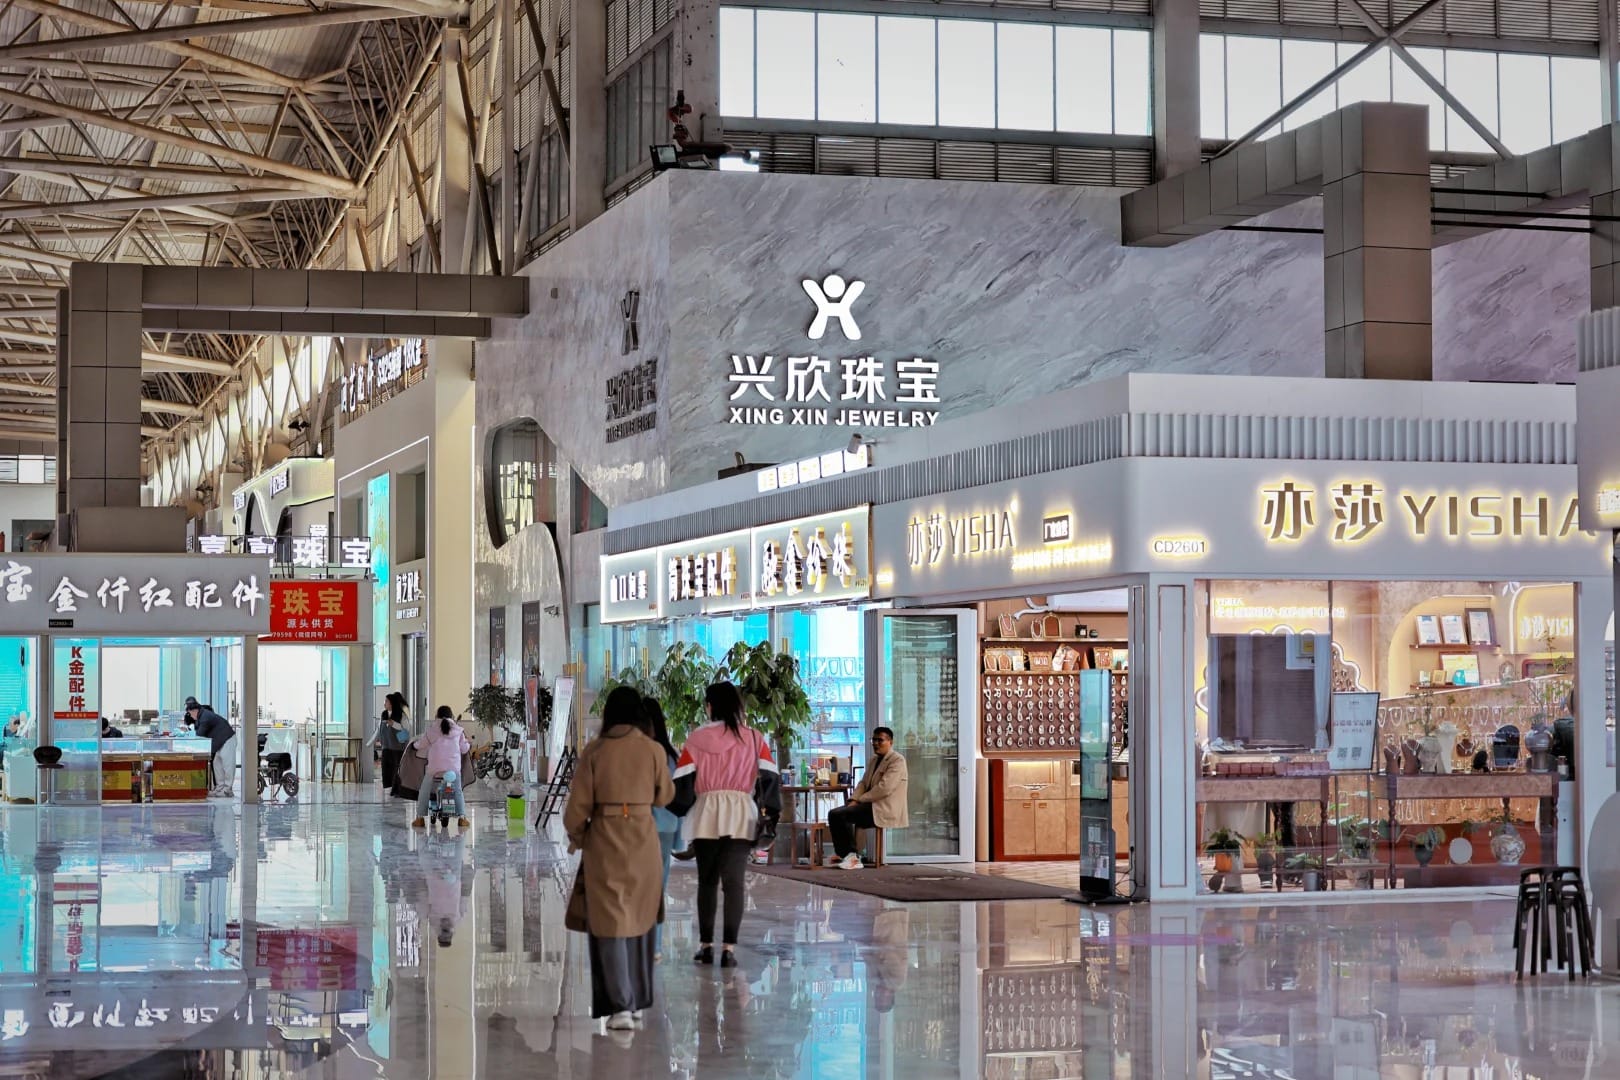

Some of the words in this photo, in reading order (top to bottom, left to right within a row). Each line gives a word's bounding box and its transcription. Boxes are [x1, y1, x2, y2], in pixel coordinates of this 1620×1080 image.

[728, 354, 942, 404] 兴欣珠宝
[728, 407, 785, 425] XING
[790, 408, 829, 426] XIN
[834, 409, 941, 428] JEWELRY
[1262, 482, 1386, 541] 亦莎
[908, 514, 944, 567] 亦莎
[949, 511, 1014, 556] YISHA
[1154, 540, 1205, 553] CD2601
[48, 575, 265, 617] 金仟红配件
[270, 587, 344, 616] 珠宝
[286, 618, 335, 629] 源头供货
[69, 646, 86, 712] K金配件
